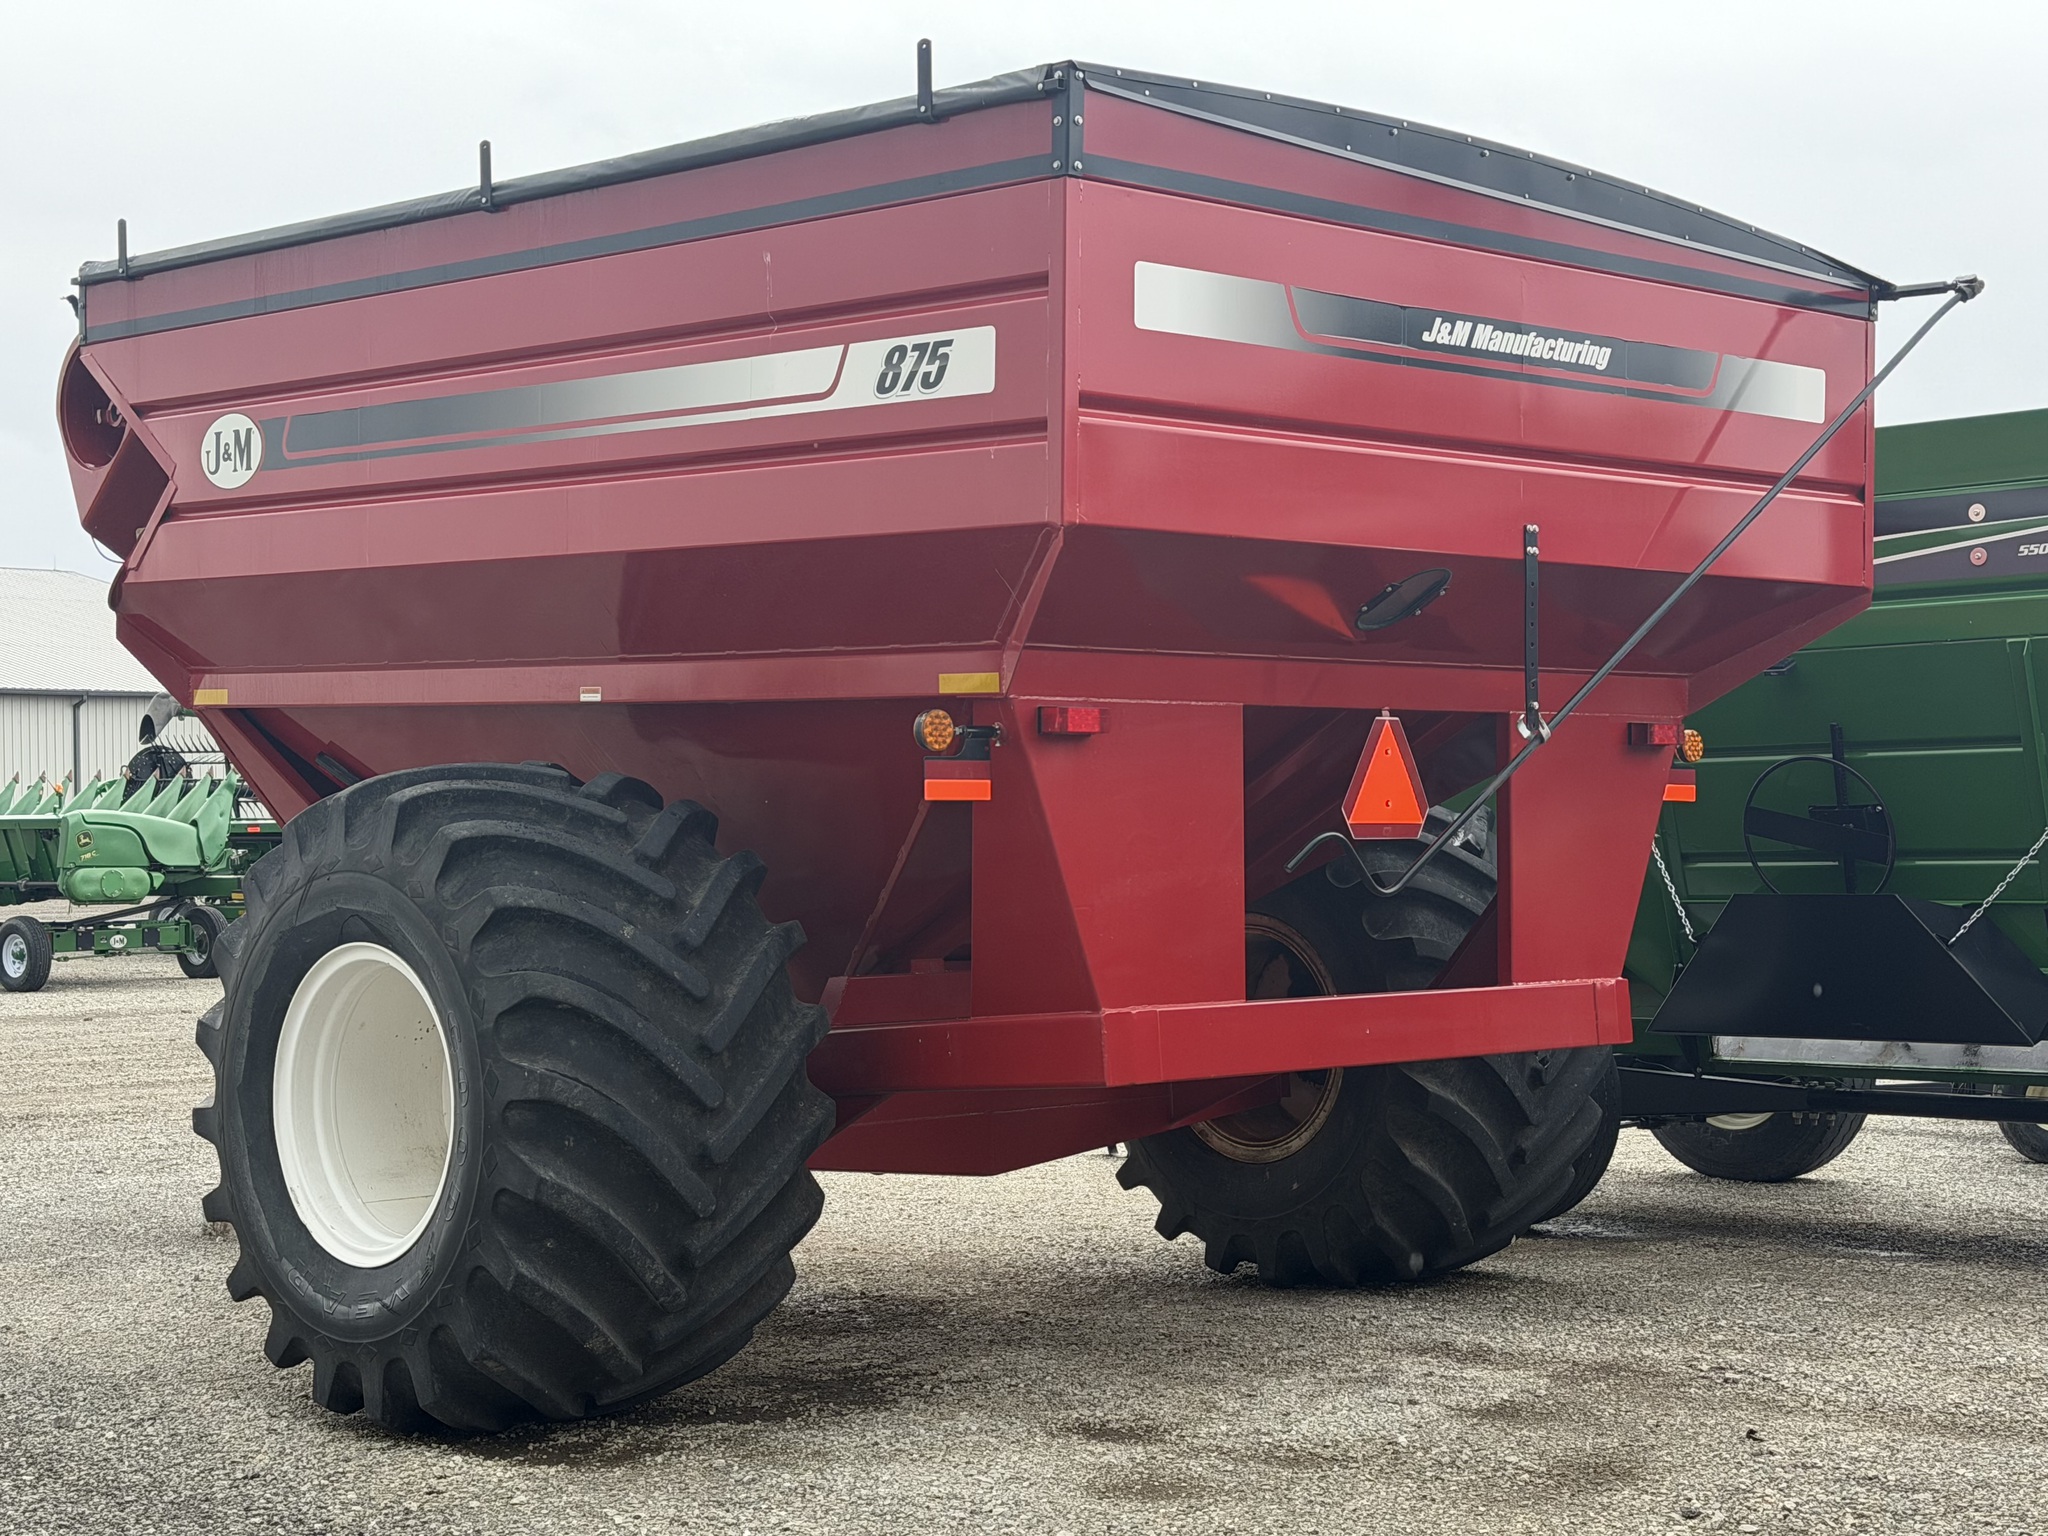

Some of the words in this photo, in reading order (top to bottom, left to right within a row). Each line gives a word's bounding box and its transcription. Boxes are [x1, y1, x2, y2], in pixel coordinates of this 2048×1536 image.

[875, 338, 955, 397] 875
[1422, 317, 1473, 349] J&M
[1470, 323, 1613, 371] Manufacturing
[205, 427, 253, 476] J&M
